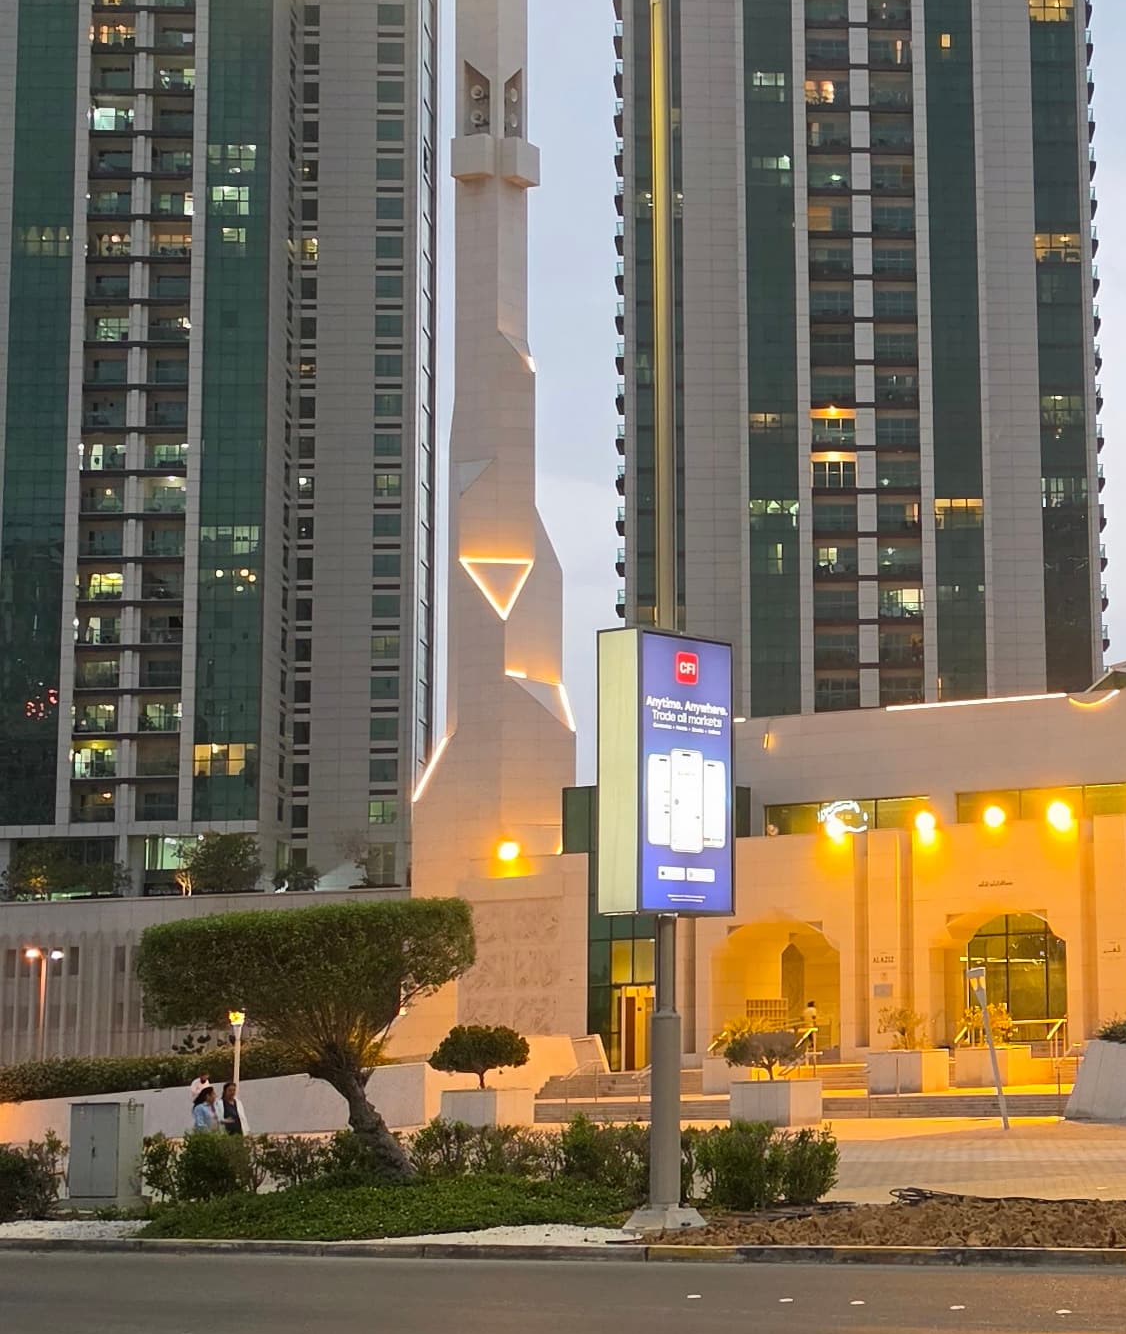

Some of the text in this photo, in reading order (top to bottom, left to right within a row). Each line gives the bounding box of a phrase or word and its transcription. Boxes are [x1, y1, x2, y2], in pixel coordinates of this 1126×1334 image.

[680, 662, 696, 676] CFI
[646, 696, 728, 716] Anytime. Anywhere.
[652, 709, 676, 722] Trade
[677, 712, 688, 723] all
[688, 715, 722, 728] markets
